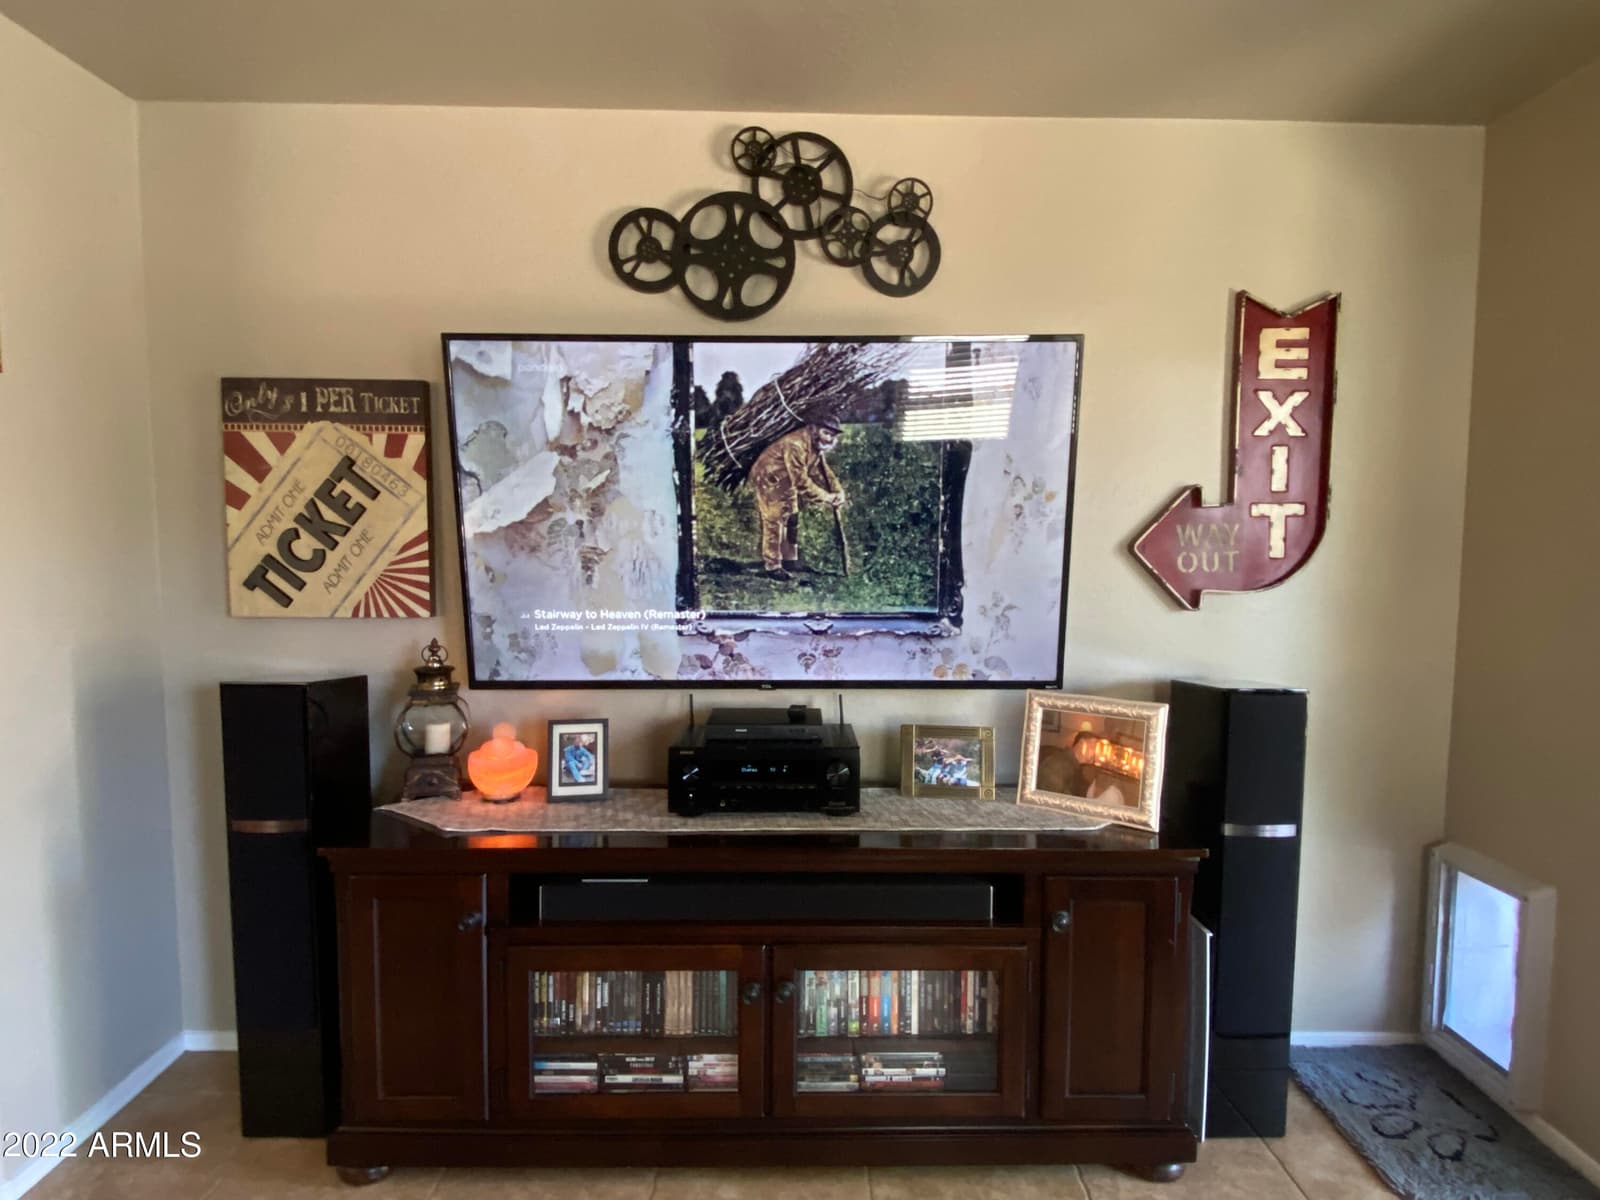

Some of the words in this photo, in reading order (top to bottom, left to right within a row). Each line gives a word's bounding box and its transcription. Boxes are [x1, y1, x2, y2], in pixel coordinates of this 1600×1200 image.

[315, 386, 356, 413] PER
[1250, 327, 1310, 560] EXIT
[256, 506, 285, 545] ADMIT
[282, 479, 307, 509] ONE
[242, 455, 381, 608] TICKET
[1176, 523, 1239, 547] WAY
[323, 554, 353, 594] ADMIT
[350, 528, 376, 560] ONE
[1177, 552, 1239, 574] OUT
[534, 609, 582, 621] Stairway
[585, 610, 597, 619] to
[600, 610, 641, 619] Heaven
[643, 609, 706, 620] (Remaster)
[551, 624, 584, 632] Zeppelin
[607, 624, 639, 632] Zeppelin
[650, 624, 693, 632] (Remaster)
